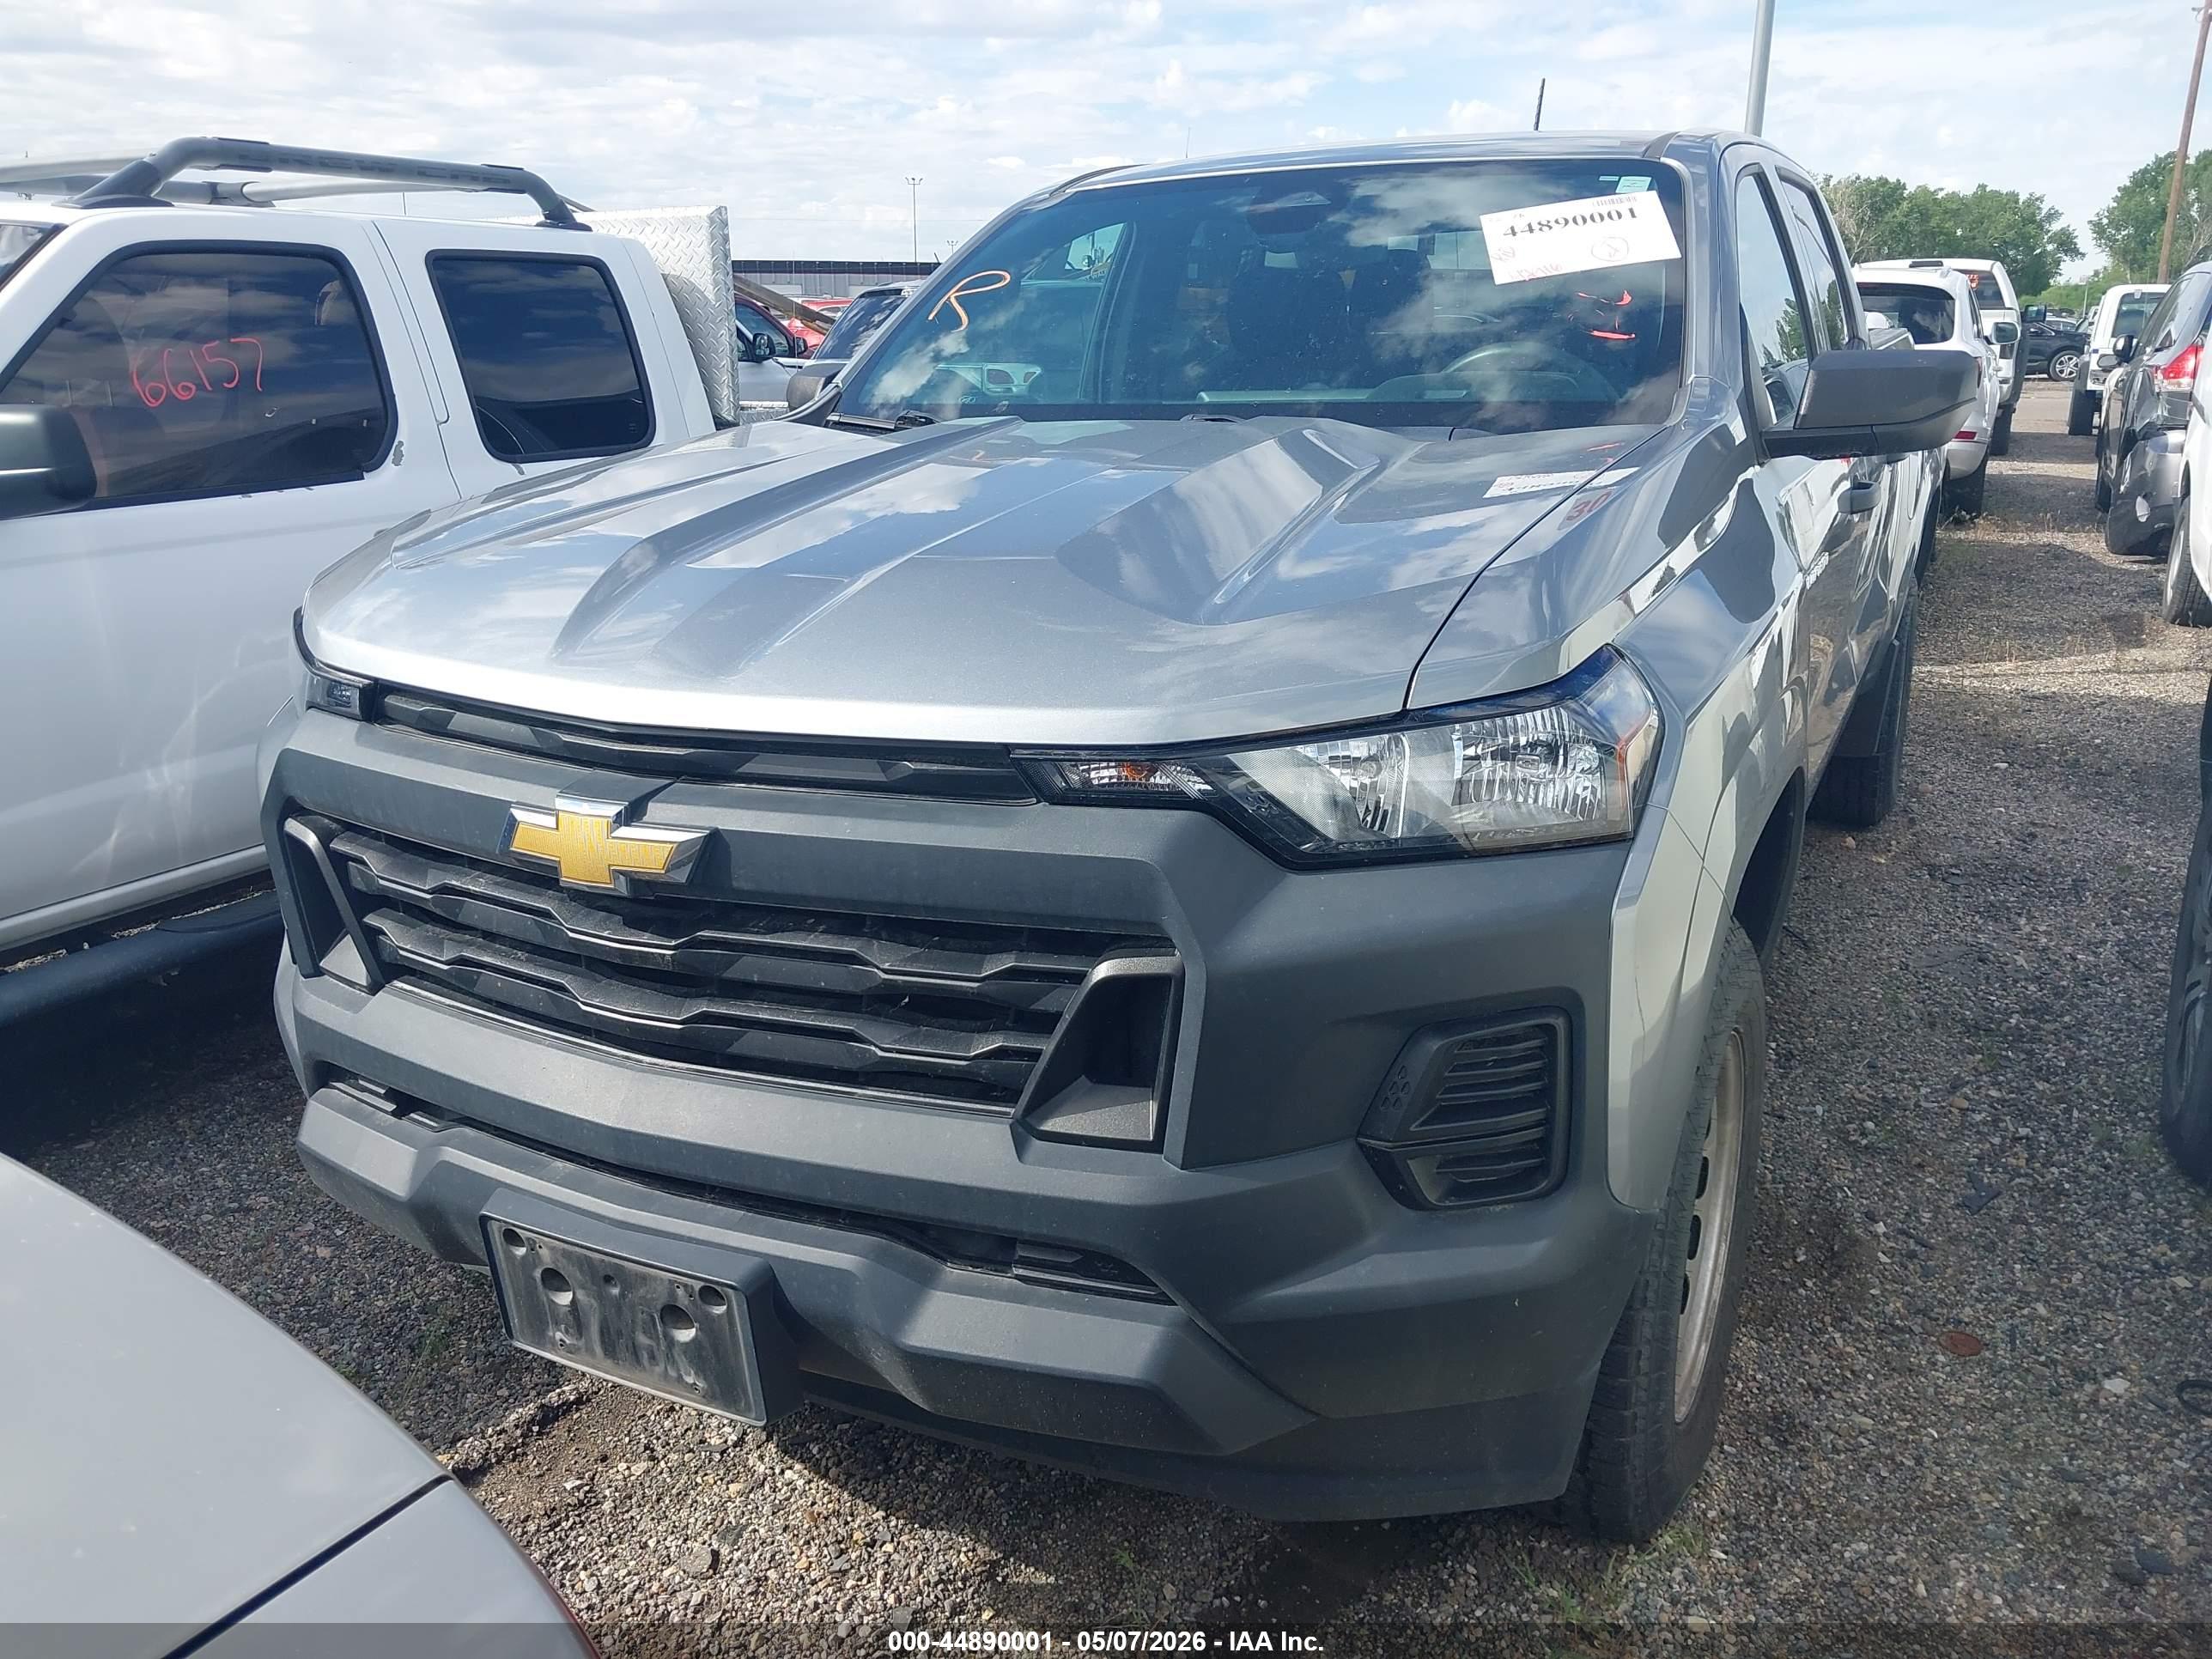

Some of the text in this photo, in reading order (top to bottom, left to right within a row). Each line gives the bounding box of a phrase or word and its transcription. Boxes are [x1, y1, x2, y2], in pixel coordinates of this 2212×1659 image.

[1503, 207, 1638, 237] 44890001
[927, 270, 1011, 333] R
[132, 337, 263, 407] 66157
